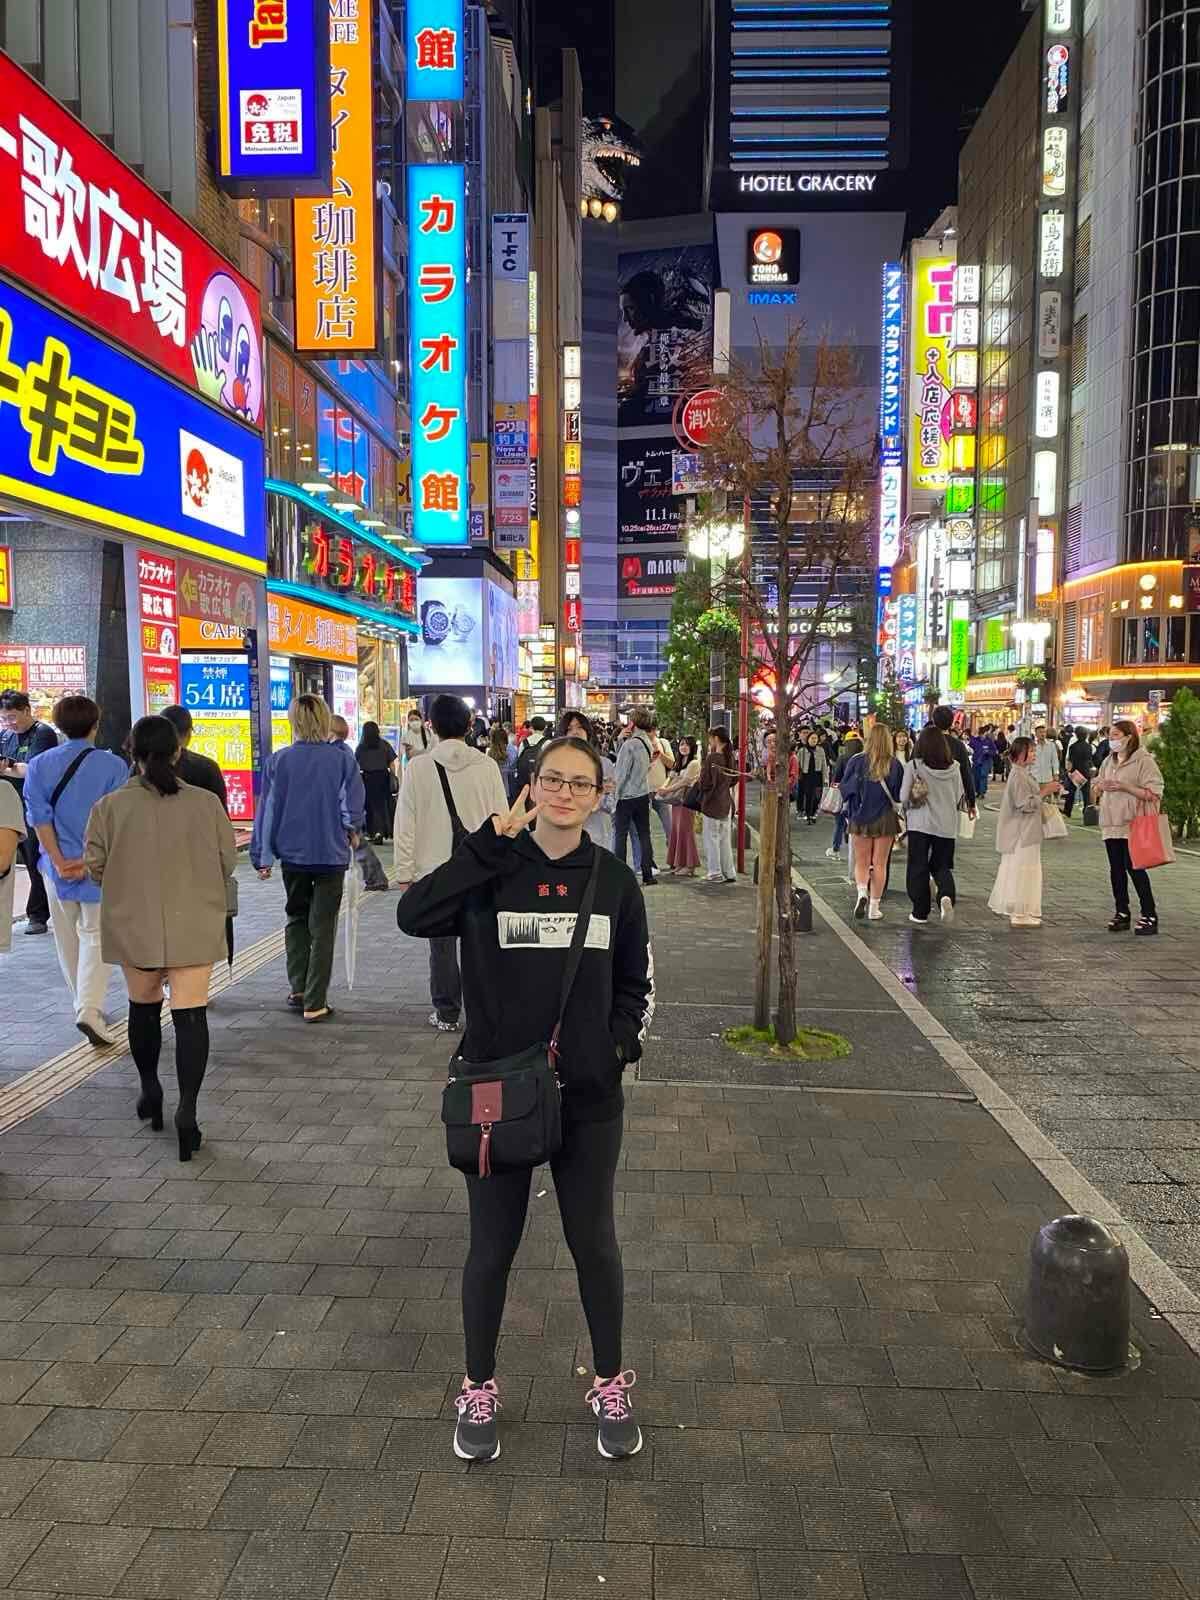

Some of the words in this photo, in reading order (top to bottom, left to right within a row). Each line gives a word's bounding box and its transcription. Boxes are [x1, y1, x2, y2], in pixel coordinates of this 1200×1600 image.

[250, 0, 286, 47] Ta
[417, 27, 457, 70] 館
[251, 122, 293, 142] 免税
[740, 175, 795, 192] HOTEL
[798, 174, 878, 192] GRACERY
[752, 264, 779, 273] TOHO
[752, 273, 788, 282] CINEMAS
[750, 293, 797, 304] IMAX
[418, 196, 459, 513] カラオケ館
[646, 507, 667, 520] 11.1
[138, 559, 173, 584] カラオケ
[198, 569, 232, 596] カラオケ
[142, 593, 173, 618] 歌広場
[29, 648, 84, 665] KARAOKE
[185, 682, 245, 707] 54席
